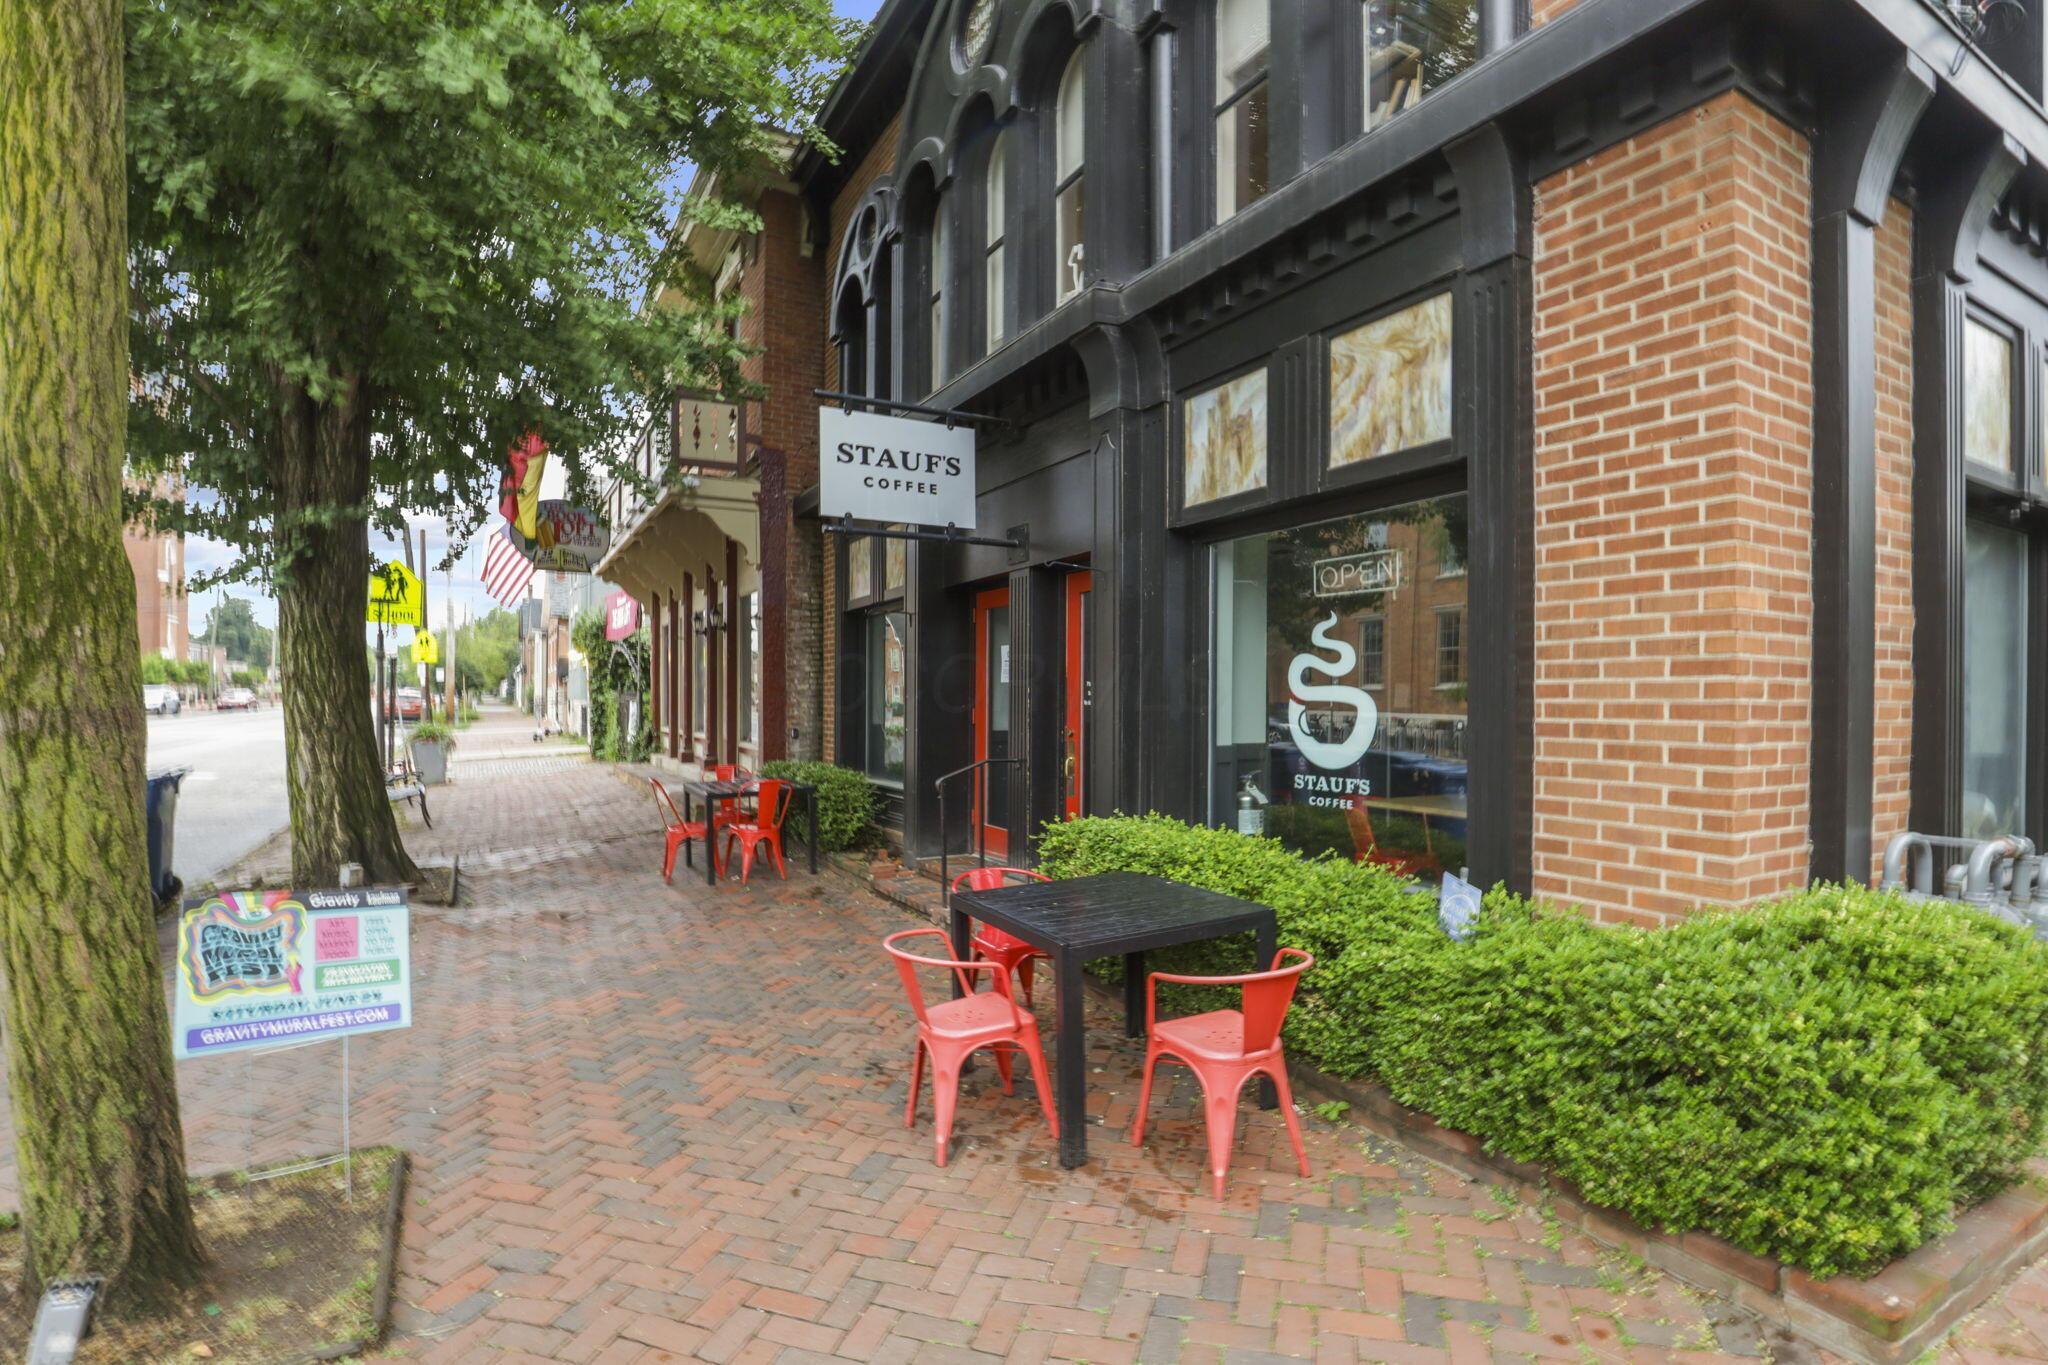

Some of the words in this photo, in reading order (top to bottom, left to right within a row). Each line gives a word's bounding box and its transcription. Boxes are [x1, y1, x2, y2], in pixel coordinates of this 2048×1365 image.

[836, 442, 961, 477] STAUF'S
[863, 476, 938, 495] COFFEE
[1319, 558, 1394, 589] OPEN
[373, 608, 415, 621] SOOL
[1293, 774, 1371, 796] STAUF'S
[1308, 796, 1353, 810] COFFEE
[309, 891, 360, 908] Gravity
[200, 1006, 390, 1045] GRAVITYMURALFEST.COM
